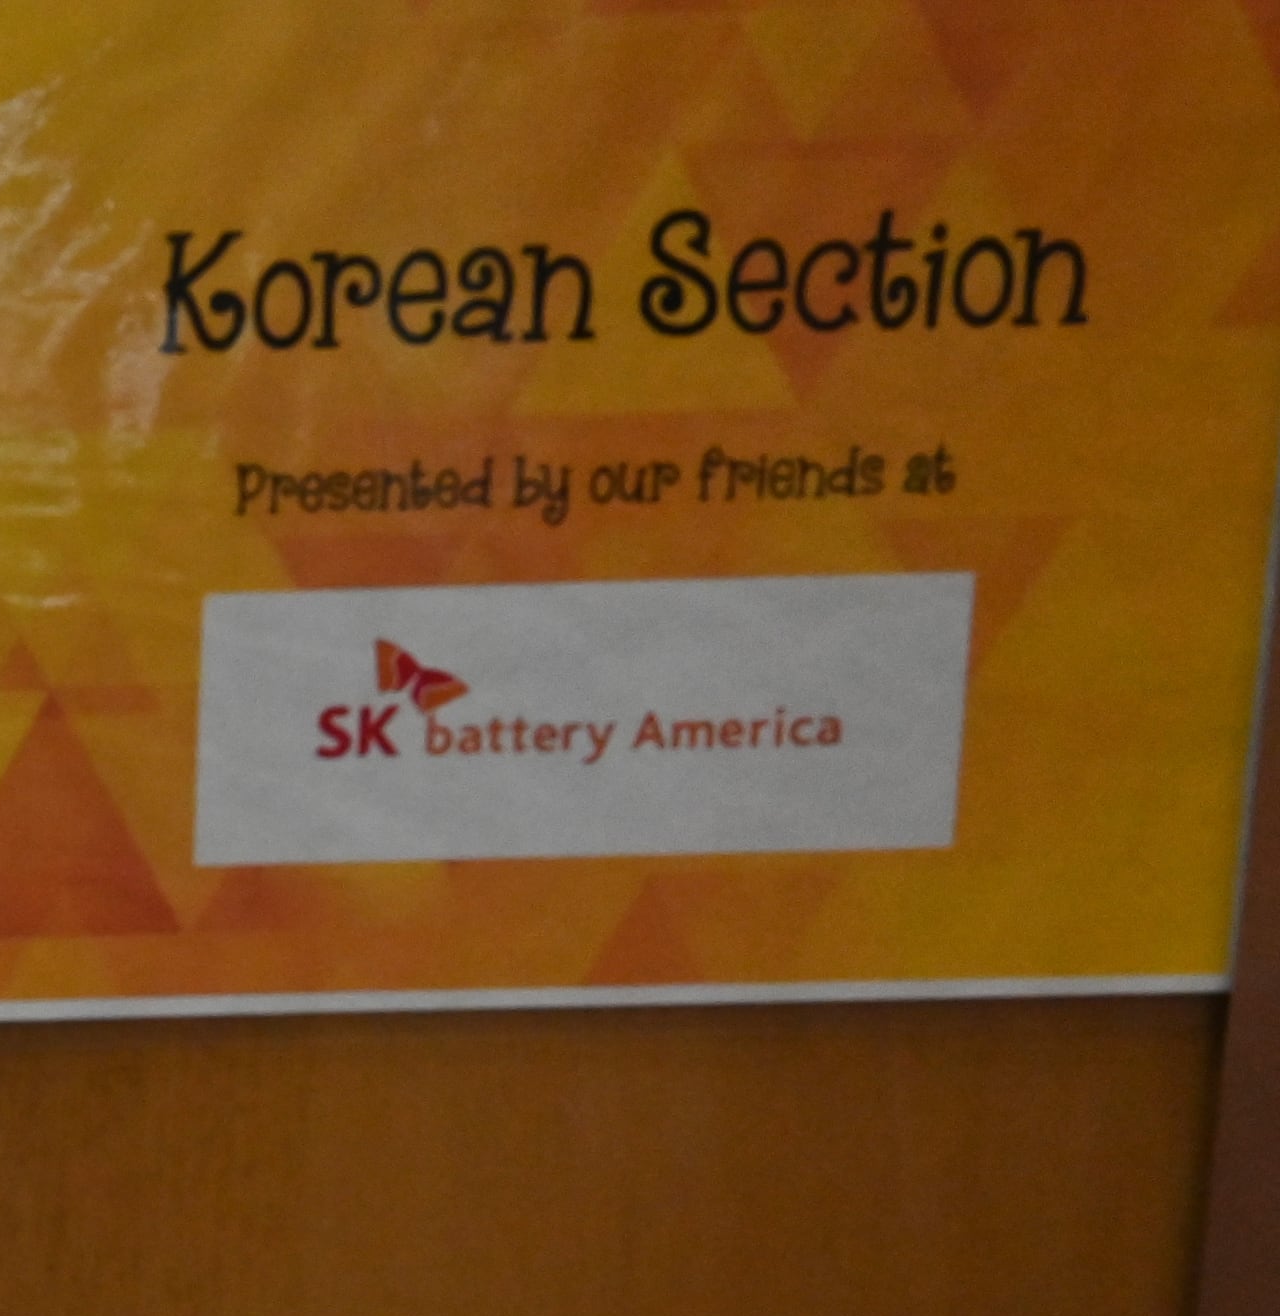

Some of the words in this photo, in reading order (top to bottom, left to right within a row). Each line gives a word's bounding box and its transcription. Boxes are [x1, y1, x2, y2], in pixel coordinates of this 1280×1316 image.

[159, 229, 597, 354] Korean
[639, 208, 1090, 336] Section
[233, 455, 494, 517] Presented
[512, 452, 575, 528] by
[587, 455, 683, 510] our
[694, 445, 888, 505] friends
[900, 439, 958, 497] at
[314, 702, 402, 760] SK
[423, 713, 618, 767] battery
[632, 705, 845, 751] America
